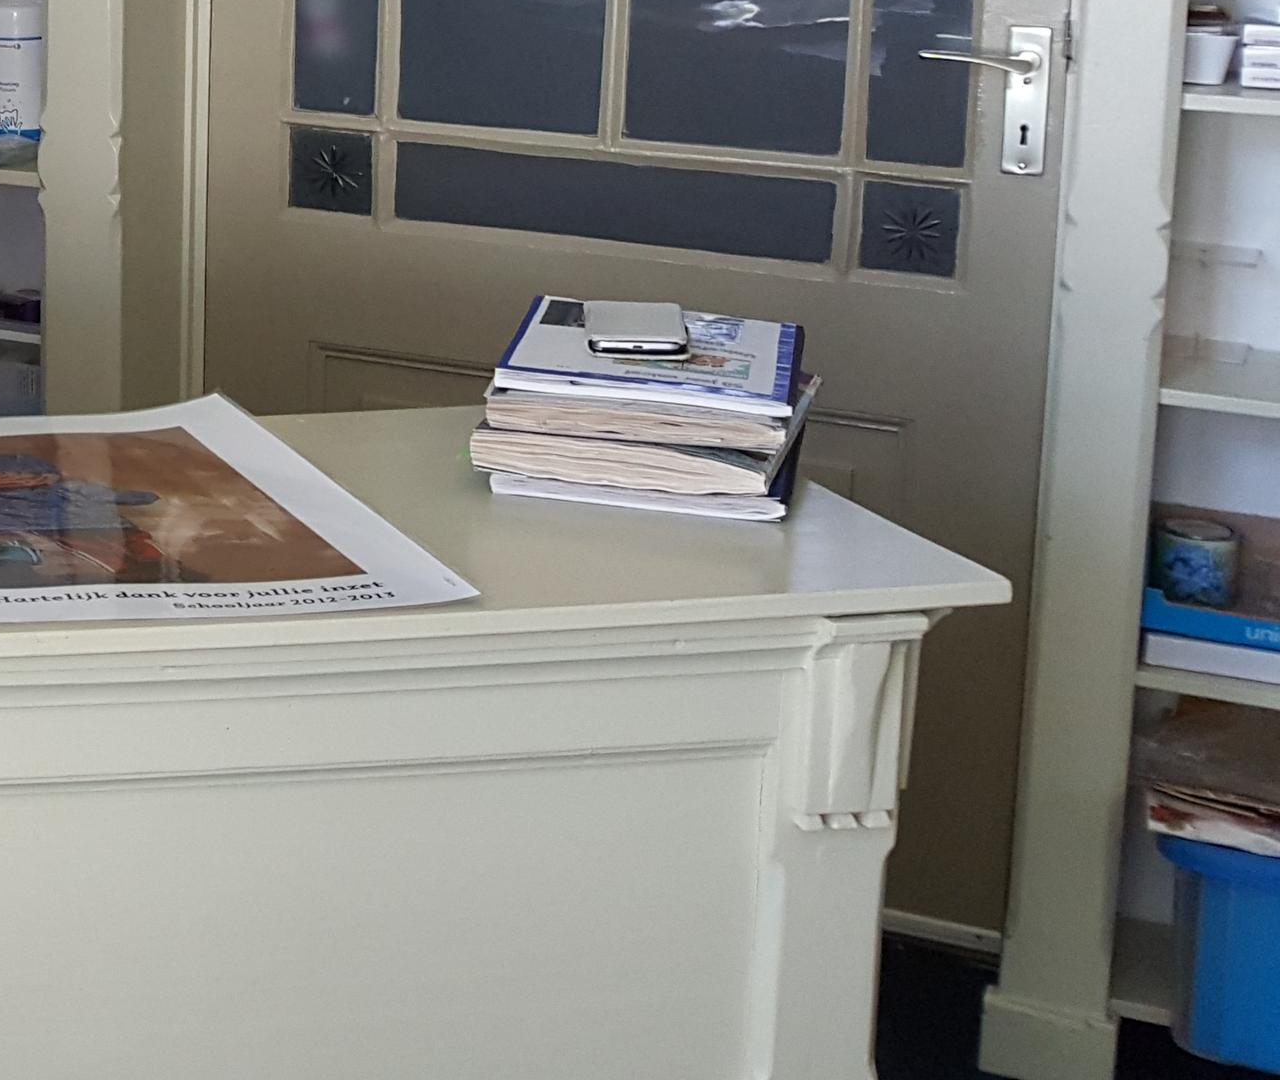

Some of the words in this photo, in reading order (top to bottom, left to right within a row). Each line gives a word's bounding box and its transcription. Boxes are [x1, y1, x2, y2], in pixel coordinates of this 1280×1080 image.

[114, 589, 179, 599] dank
[183, 591, 241, 599] voor
[246, 586, 315, 600] jullie
[319, 581, 385, 593] inzet
[290, 592, 397, 607] 2012-2013
